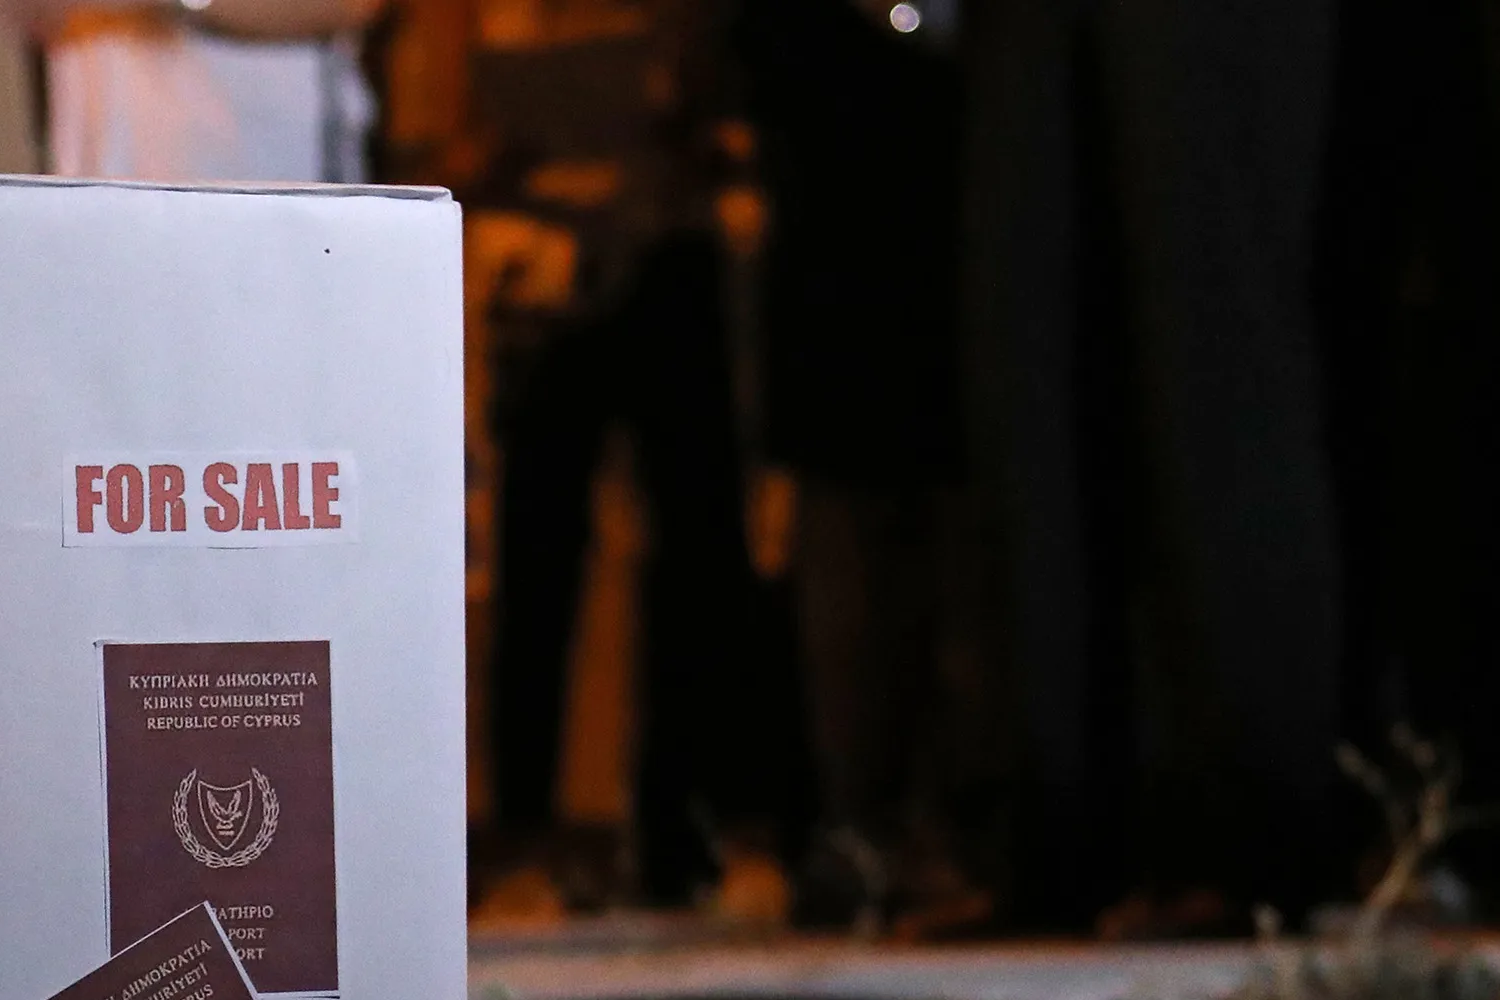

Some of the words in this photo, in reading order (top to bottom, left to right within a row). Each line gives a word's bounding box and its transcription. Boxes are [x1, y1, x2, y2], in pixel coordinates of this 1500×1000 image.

[75, 463, 187, 534] FOR
[202, 461, 342, 533] SALE
[147, 716, 218, 730] REPUBLIC
[220, 715, 240, 728] OF
[243, 714, 301, 727] CYPRUS
[228, 927, 265, 940] PORT
